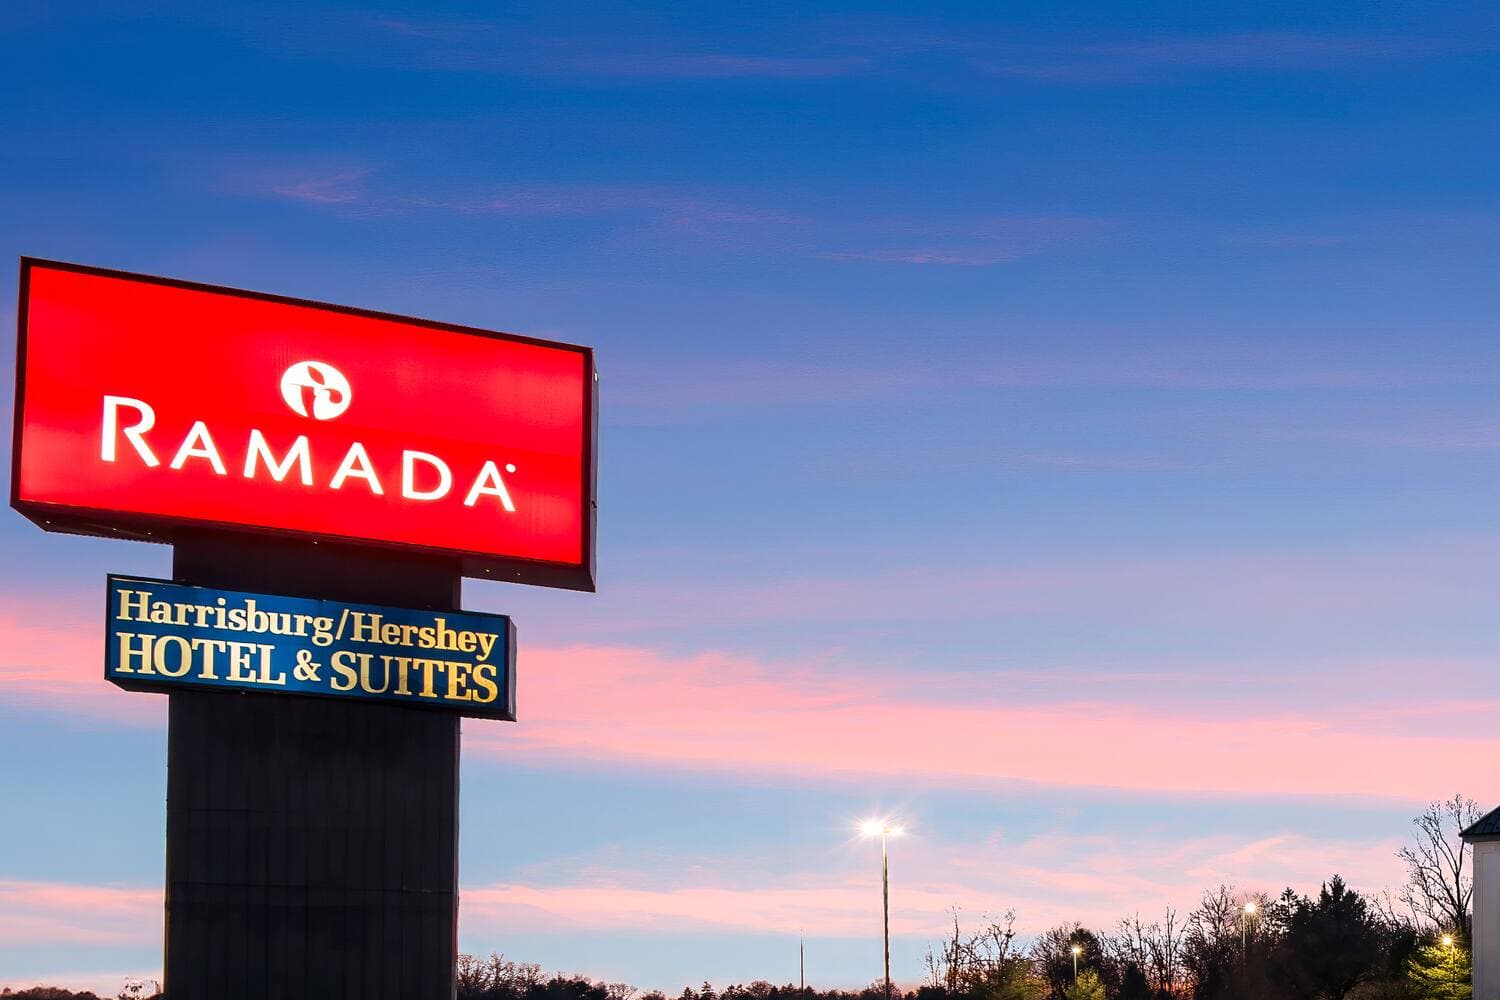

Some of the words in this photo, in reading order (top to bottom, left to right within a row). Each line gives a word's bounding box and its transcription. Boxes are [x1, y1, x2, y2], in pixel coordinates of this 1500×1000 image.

[101, 394, 516, 512] RAMADA
[116, 589, 499, 662] Harrisburg/Hershey
[115, 632, 287, 685] HOTEL
[293, 649, 322, 682] &
[330, 650, 499, 703] SUITES
